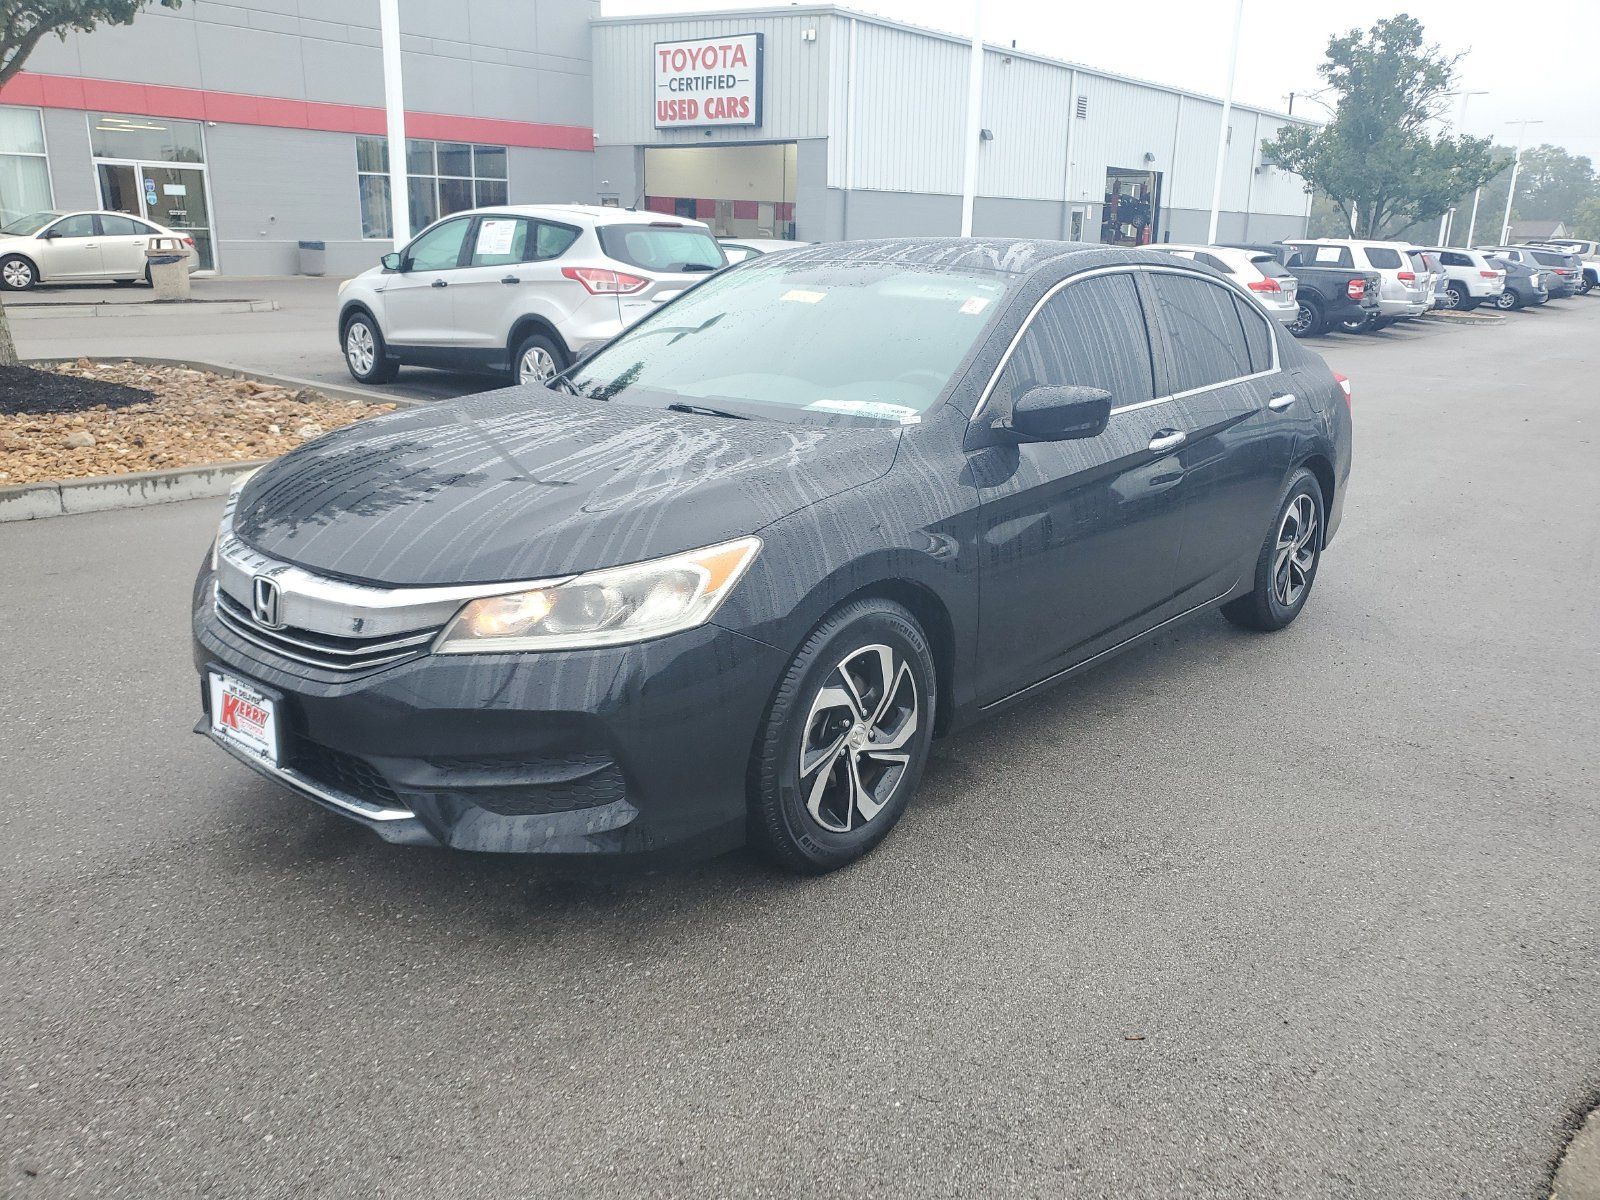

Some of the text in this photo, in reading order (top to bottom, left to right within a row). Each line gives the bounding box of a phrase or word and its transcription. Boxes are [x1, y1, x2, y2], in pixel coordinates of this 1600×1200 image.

[659, 44, 747, 73] TOYOTA
[668, 75, 736, 92] CERTIFIED
[657, 96, 750, 121] USED CARS
[891, 620, 923, 651] MICHELIN
